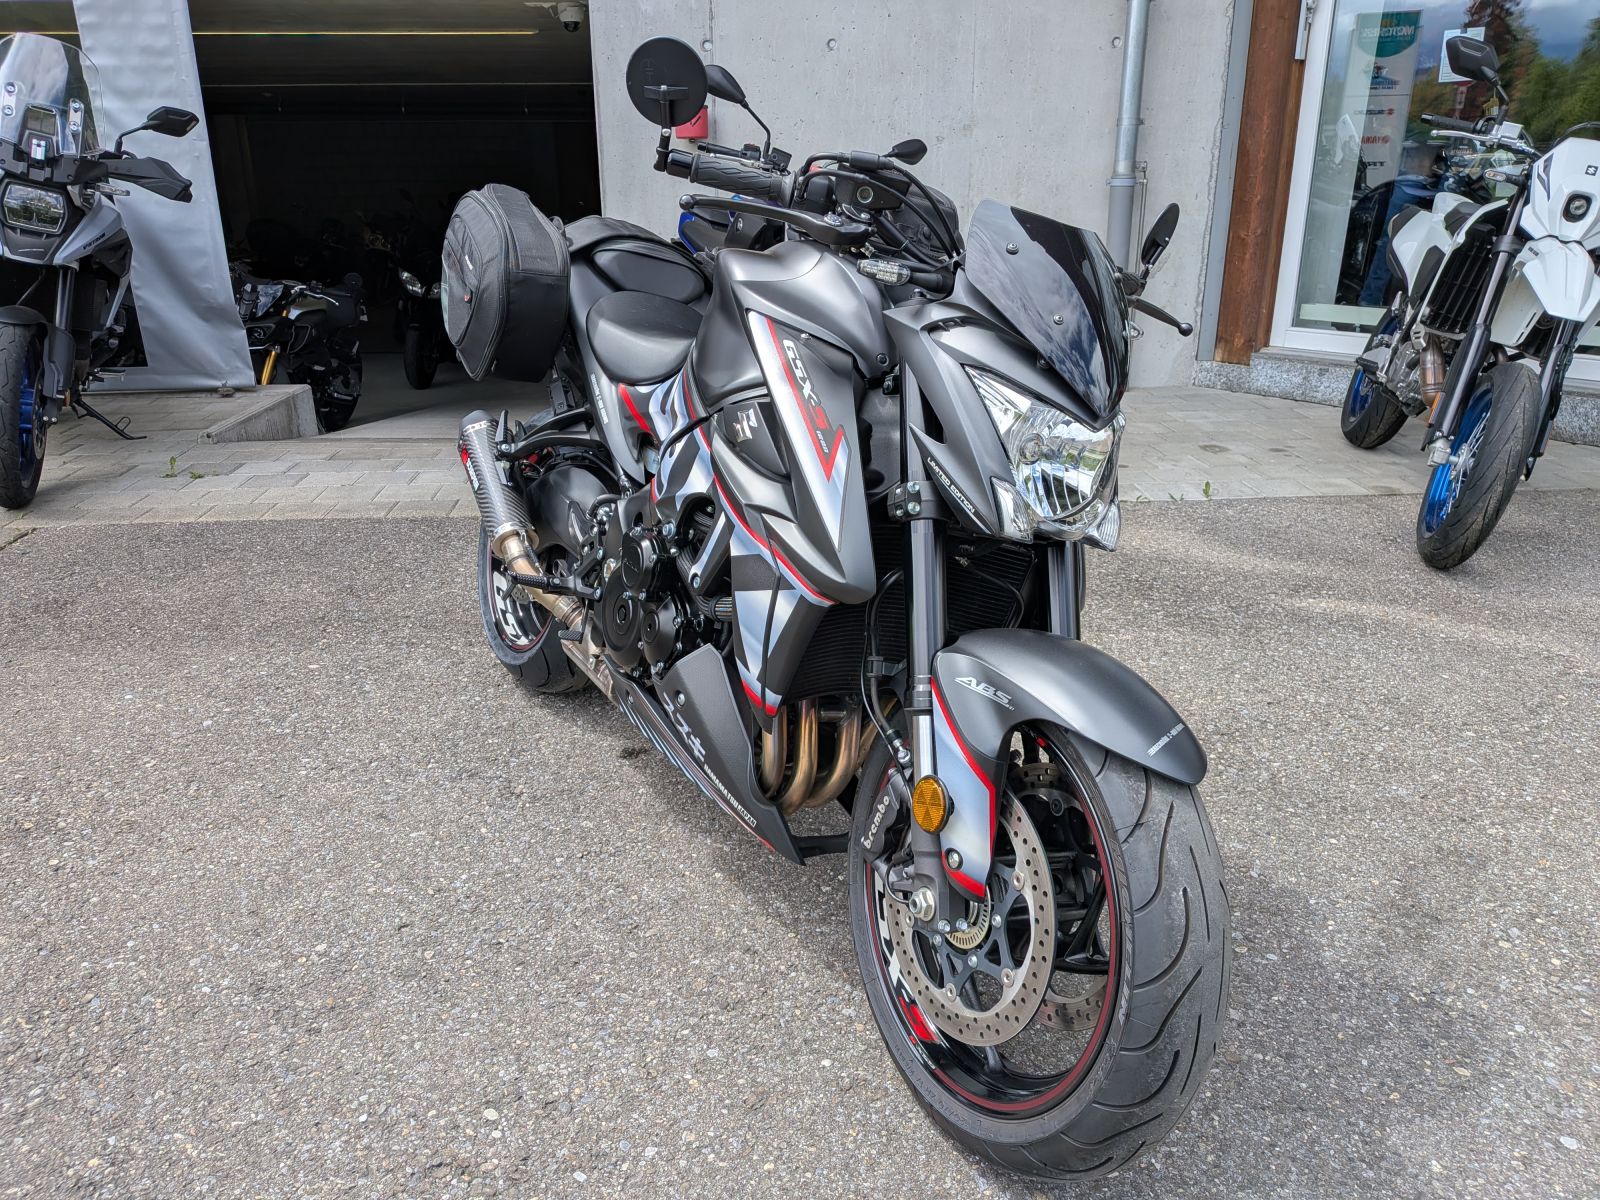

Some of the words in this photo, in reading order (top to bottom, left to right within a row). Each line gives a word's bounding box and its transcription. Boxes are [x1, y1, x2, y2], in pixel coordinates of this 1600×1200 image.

[783, 339, 829, 430] GSX-S
[927, 457, 951, 486] LIMITED
[950, 485, 976, 513] EDITION
[954, 676, 1012, 708] ABS
[863, 795, 890, 849] brembo
